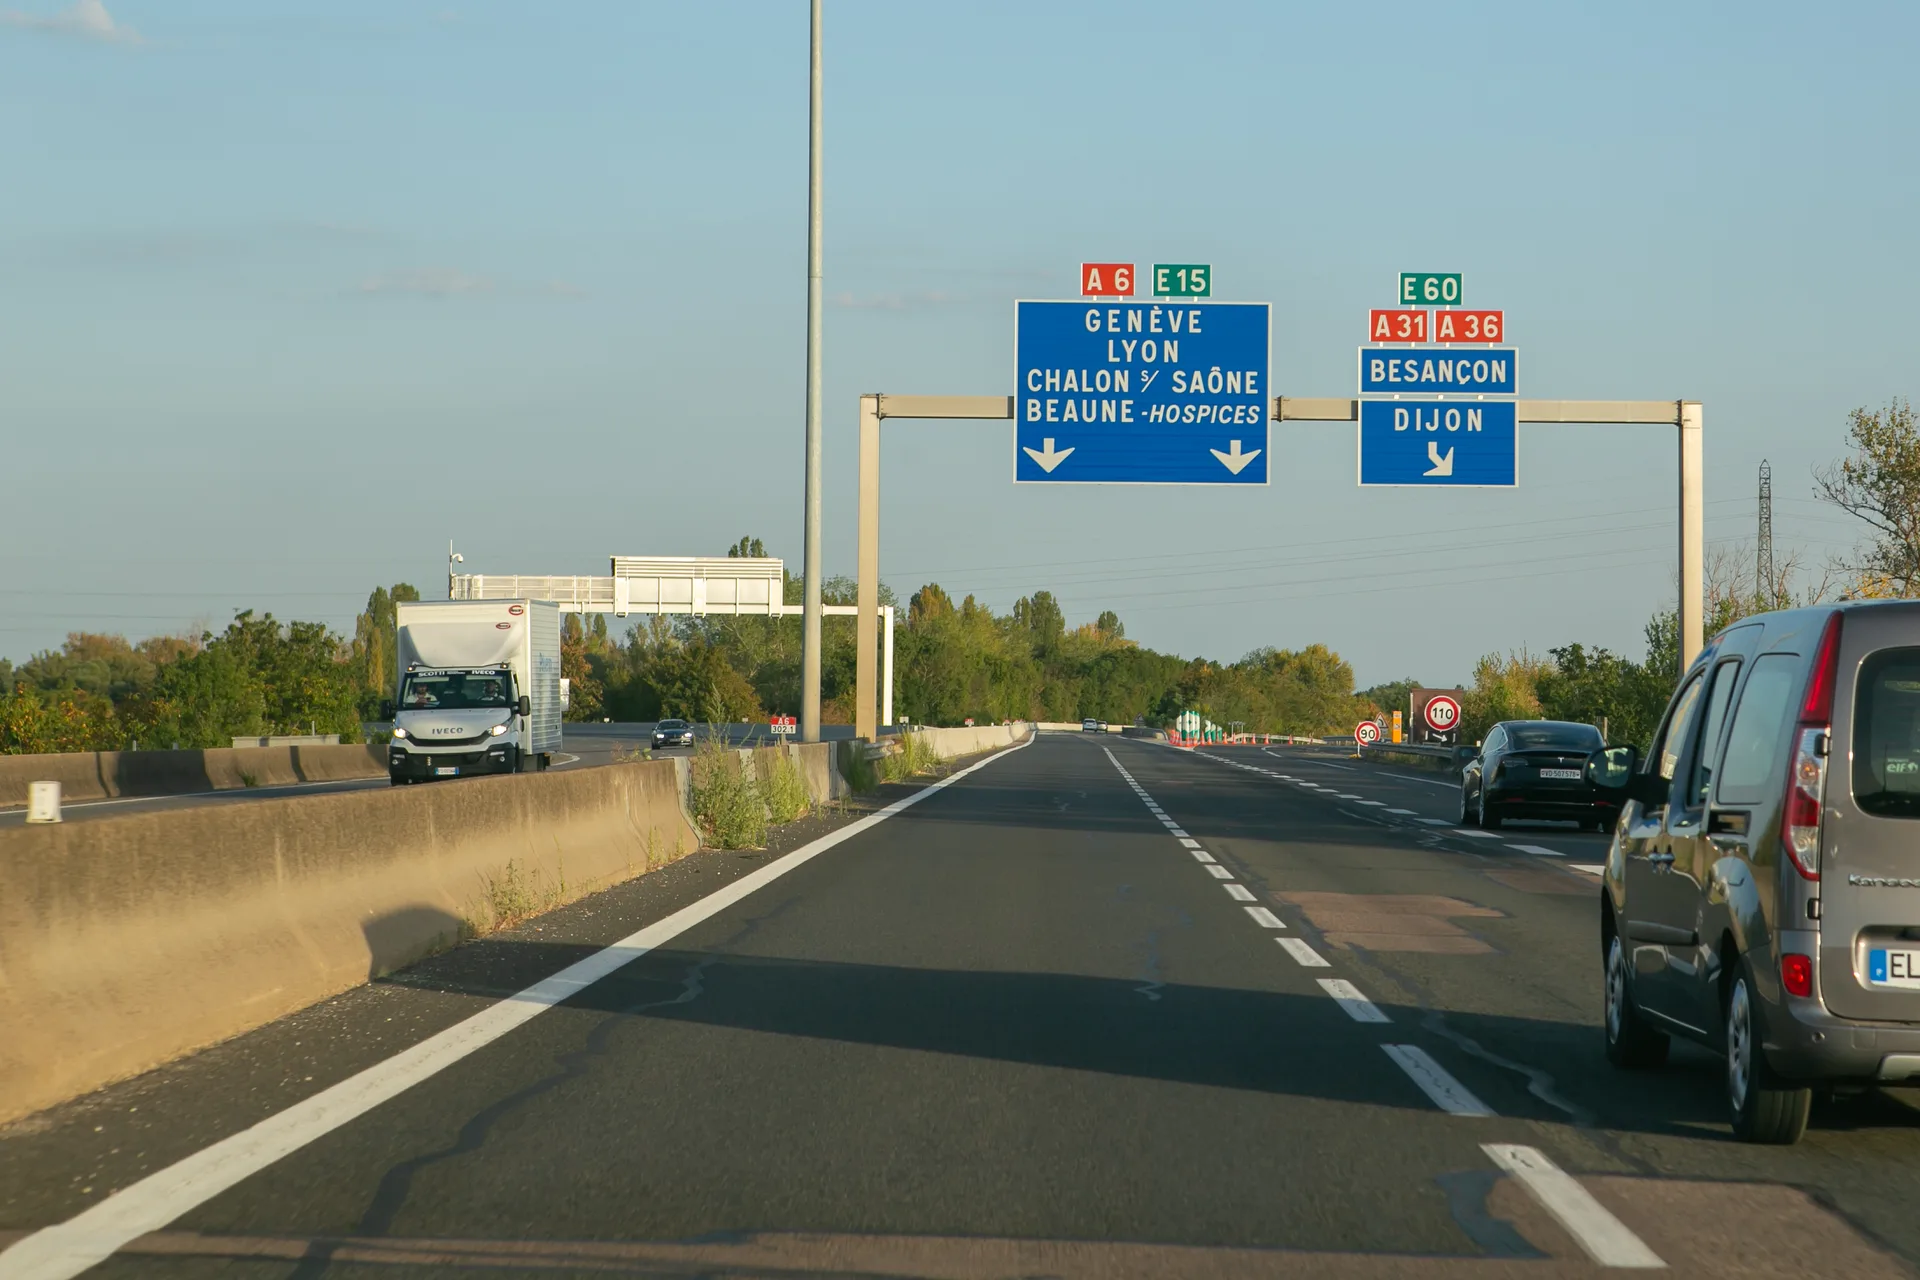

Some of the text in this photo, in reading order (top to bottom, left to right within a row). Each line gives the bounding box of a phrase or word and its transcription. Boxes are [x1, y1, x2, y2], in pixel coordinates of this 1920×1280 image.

[1086, 268, 1130, 292] A 6
[1085, 305, 1202, 334] GENÈVE
[1107, 339, 1179, 363] LYON
[1027, 368, 1130, 393] CHALON
[1172, 366, 1259, 394] SAÔNE
[1370, 359, 1507, 385] BESANÇON
[1027, 399, 1135, 423] BEAUNE
[1394, 408, 1482, 432] DIJON
[1432, 707, 1454, 720] 110
[431, 727, 464, 735] IVECO
[1360, 729, 1376, 740] 90
